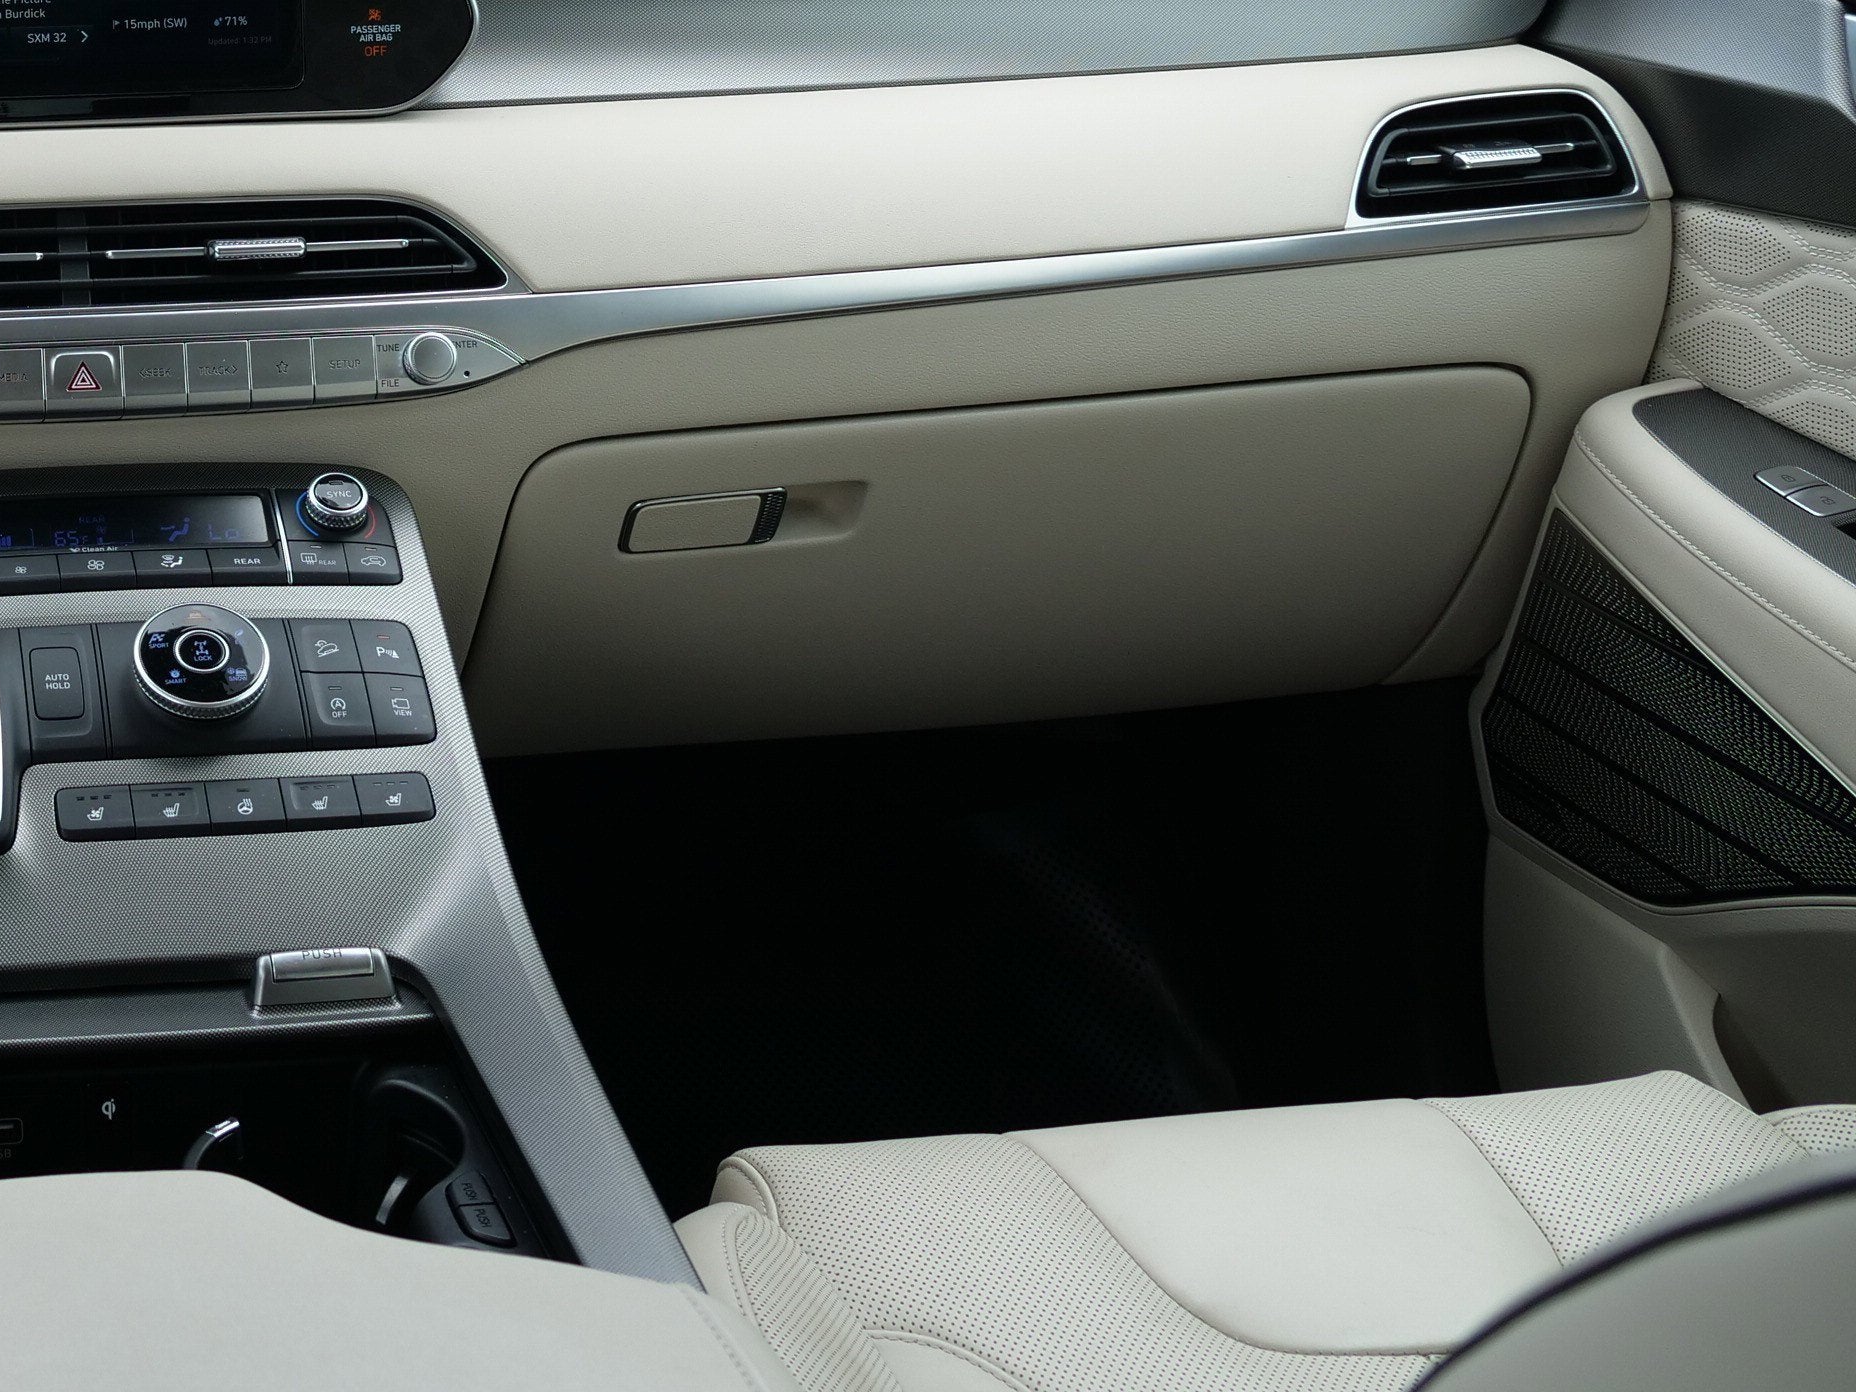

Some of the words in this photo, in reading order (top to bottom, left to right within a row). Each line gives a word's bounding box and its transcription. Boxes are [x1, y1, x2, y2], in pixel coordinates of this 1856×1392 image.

[5, 8, 46, 19] Burdick
[124, 19, 161, 30] 15mph
[163, 17, 188, 29] (SW)
[224, 16, 248, 26] 71%
[350, 24, 401, 34] PASSENGER
[27, 33, 50, 44] SXM
[53, 32, 67, 43] 32
[359, 34, 374, 42] AIR
[375, 33, 393, 42] BAG
[364, 45, 388, 57] OFF
[376, 343, 400, 354] TUNE
[328, 359, 362, 371] SETUP
[380, 378, 400, 389] FILE
[326, 490, 353, 498] SYNC
[234, 558, 261, 566] REAR
[148, 642, 169, 650] SPORT
[193, 654, 213, 662] LOCK
[44, 673, 69, 682] AUTO
[164, 677, 187, 685] SMART
[45, 682, 71, 691] HOLD
[331, 711, 347, 719] OFF
[393, 709, 413, 717] VIEW
[302, 948, 343, 960] PUSH
[461, 1182, 478, 1201] PUSH
[473, 1208, 493, 1228] PUSH
